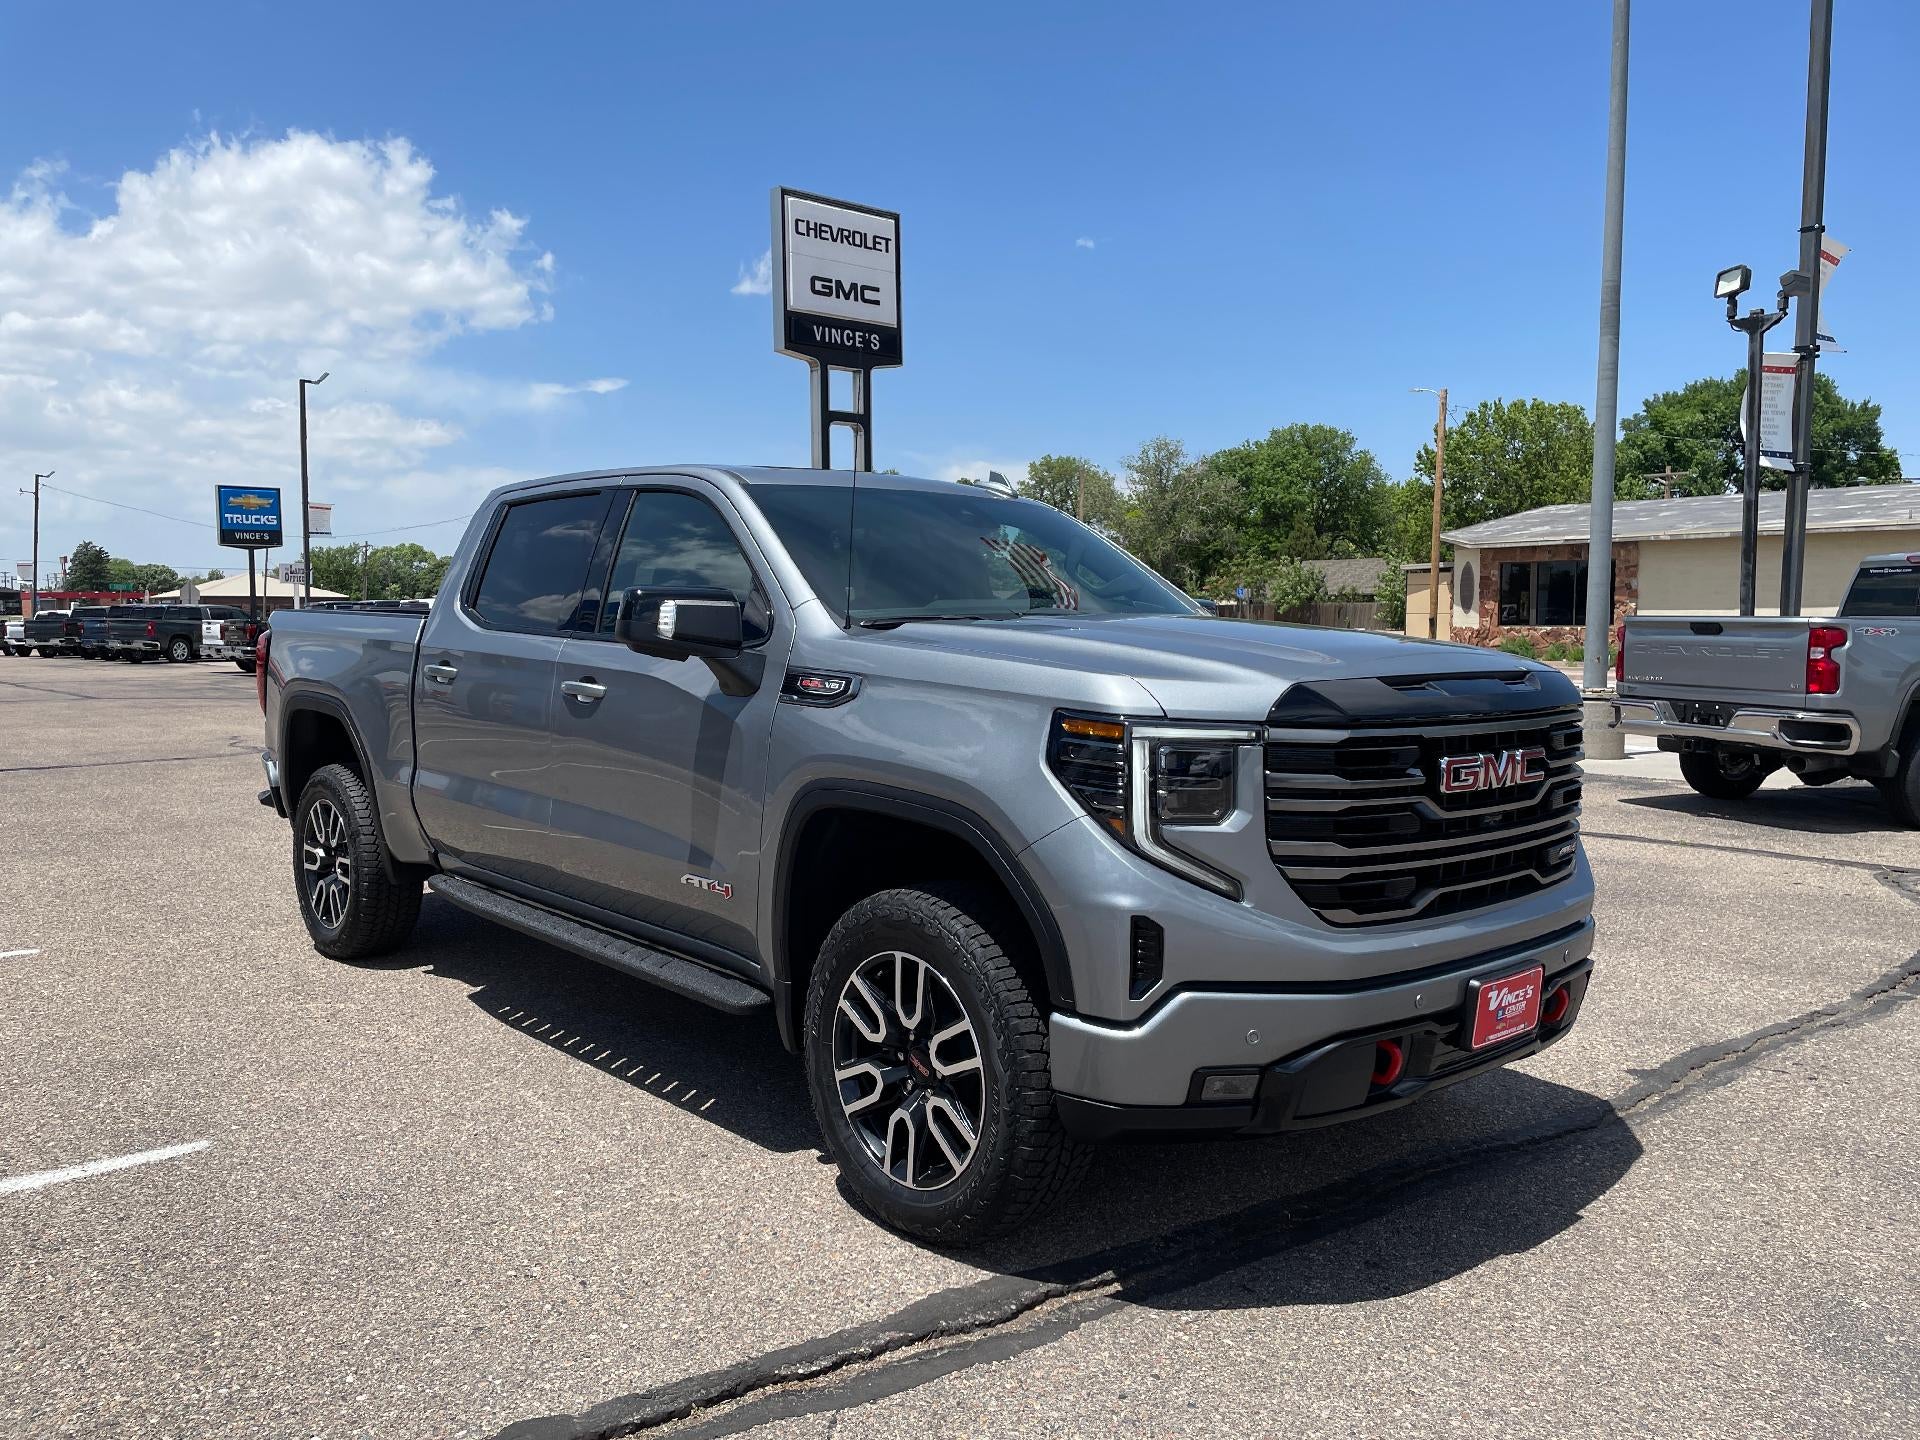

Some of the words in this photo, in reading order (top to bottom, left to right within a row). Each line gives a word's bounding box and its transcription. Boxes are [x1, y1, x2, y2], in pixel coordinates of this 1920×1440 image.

[794, 218, 892, 254] CHEVROLET
[810, 275, 881, 306] GMC
[813, 325, 880, 350] VINCE'S
[224, 513, 278, 525] TRUCKS
[235, 531, 270, 540] VINCE'S
[1633, 643, 1792, 660] CHEVROLET
[1439, 747, 1546, 794] GMC
[680, 872, 733, 900] AT4
